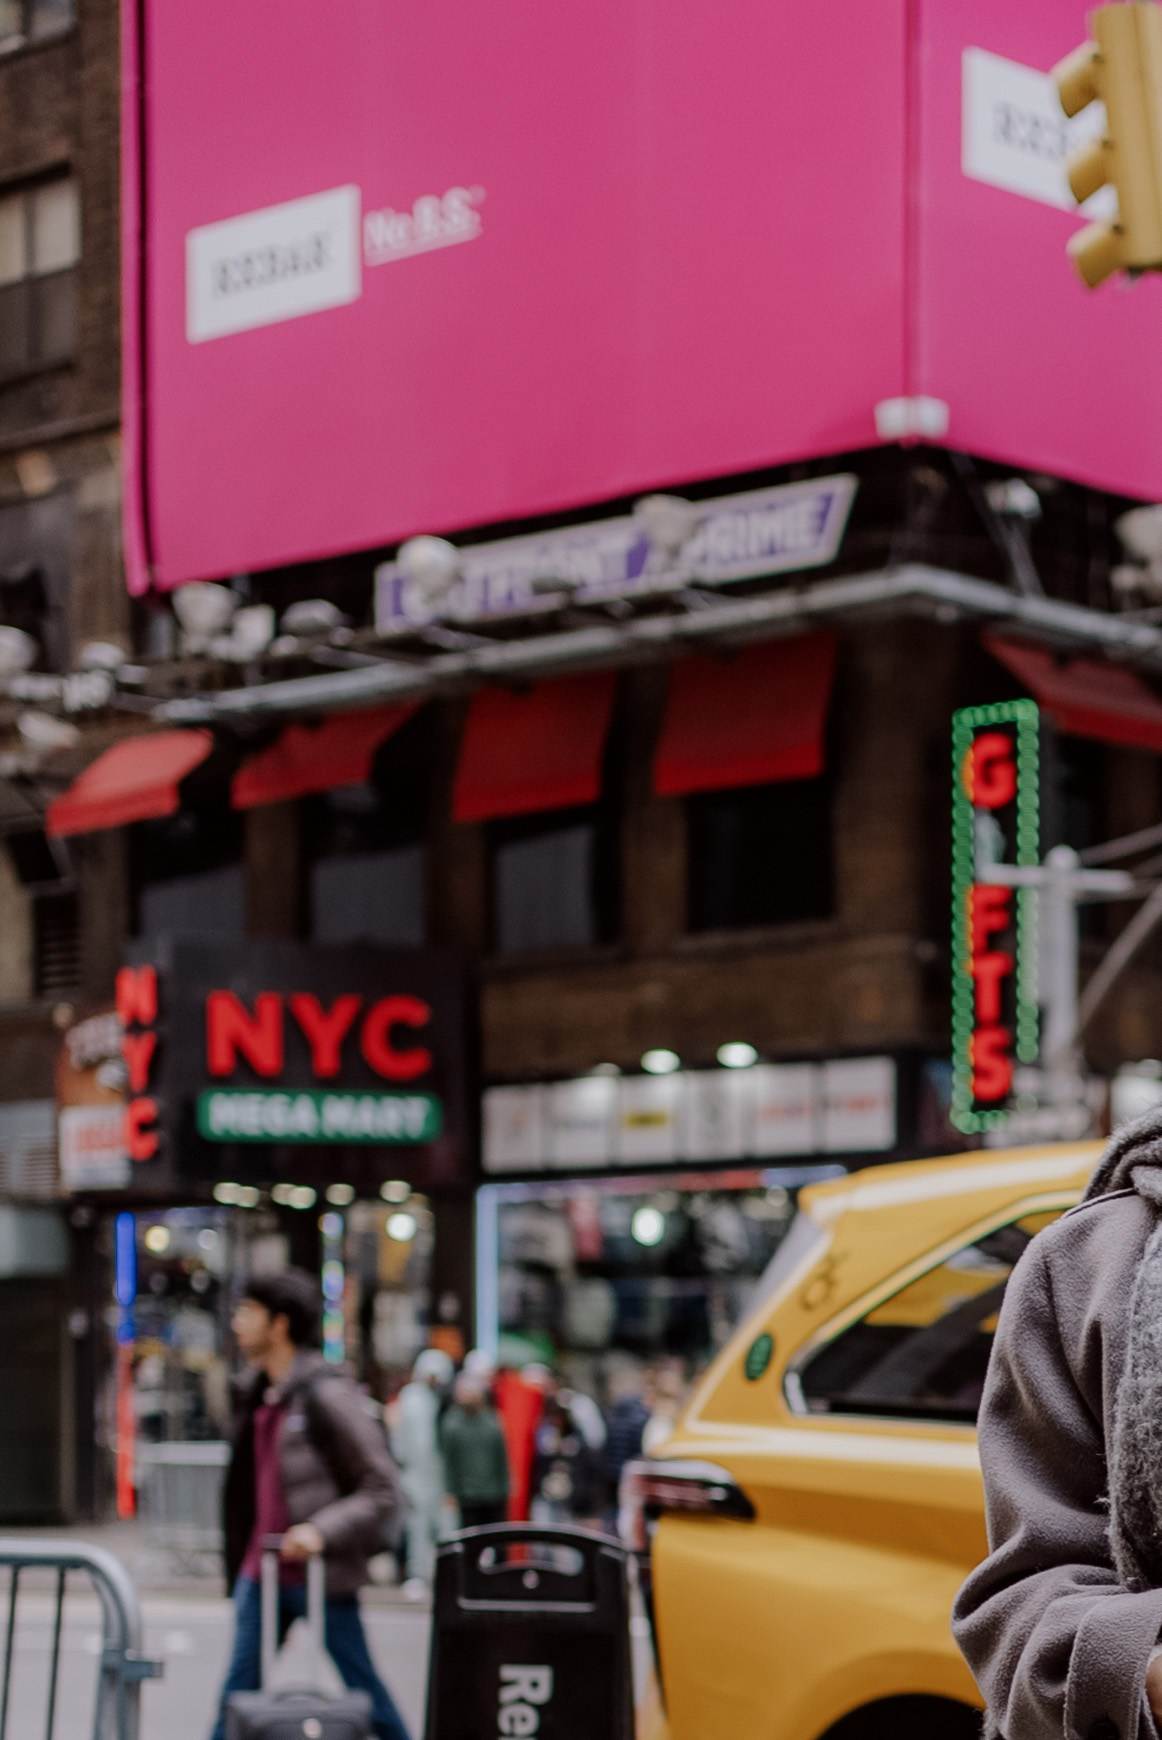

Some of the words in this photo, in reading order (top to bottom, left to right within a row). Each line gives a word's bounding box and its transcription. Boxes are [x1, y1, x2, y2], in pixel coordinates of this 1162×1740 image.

[970, 731, 1018, 1101] GFTS
[206, 989, 433, 1081] NYC
[208, 1092, 319, 1139] MEGA
[322, 1093, 431, 1140] MART
